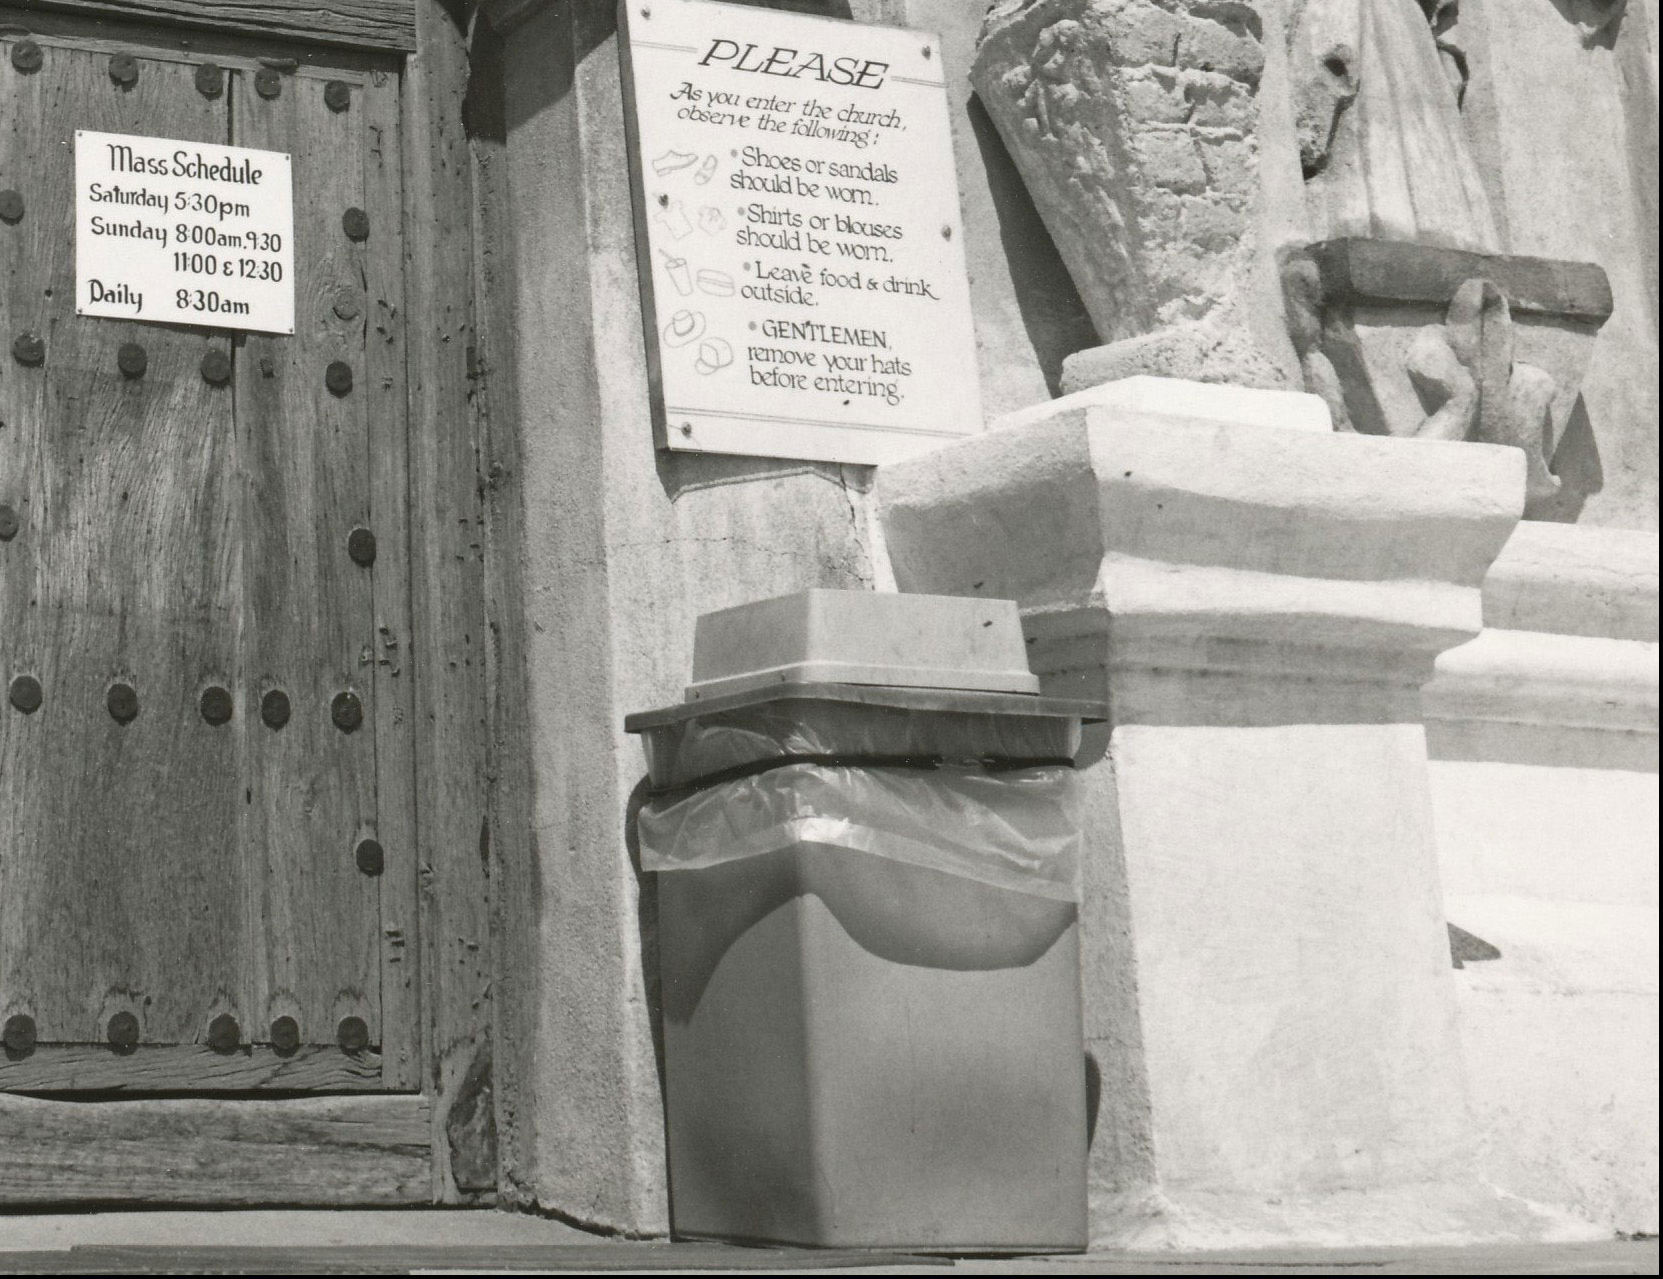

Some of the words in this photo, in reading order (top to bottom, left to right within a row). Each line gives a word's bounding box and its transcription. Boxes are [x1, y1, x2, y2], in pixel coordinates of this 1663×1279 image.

[698, 38, 889, 89] PLEASE
[670, 81, 702, 101] As
[708, 90, 740, 108] you
[746, 95, 797, 113] enter
[802, 100, 832, 120] the
[837, 103, 907, 131] church,
[677, 105, 751, 128] observe
[758, 114, 787, 133] the
[107, 143, 168, 176] Mass
[172, 151, 263, 185] Schedule
[741, 145, 801, 172] Shoes
[805, 158, 826, 173] or
[829, 162, 899, 184] sandals
[89, 183, 169, 215] Saturday
[174, 191, 250, 222] 5:30pm
[730, 169, 792, 195] should
[796, 177, 820, 198] be
[824, 184, 880, 206] worn.
[90, 216, 167, 249] Sunday
[747, 203, 803, 229] Shirts
[809, 214, 830, 231] or
[836, 213, 903, 240] blouses
[736, 227, 803, 253] should
[808, 232, 832, 256] be
[836, 242, 894, 263] worn.
[174, 251, 217, 275] 11:00
[238, 258, 283, 283] 12:30
[755, 261, 813, 285] Leave
[820, 268, 862, 291] food
[866, 277, 880, 292] &
[882, 276, 941, 301] drink
[88, 278, 143, 314] Daily
[176, 288, 250, 315] 8:30am
[740, 284, 819, 307] outside.
[748, 346, 818, 366] remove
[823, 353, 868, 373] your
[871, 354, 912, 377] hats
[749, 364, 808, 390] before
[814, 375, 905, 406] entering.
